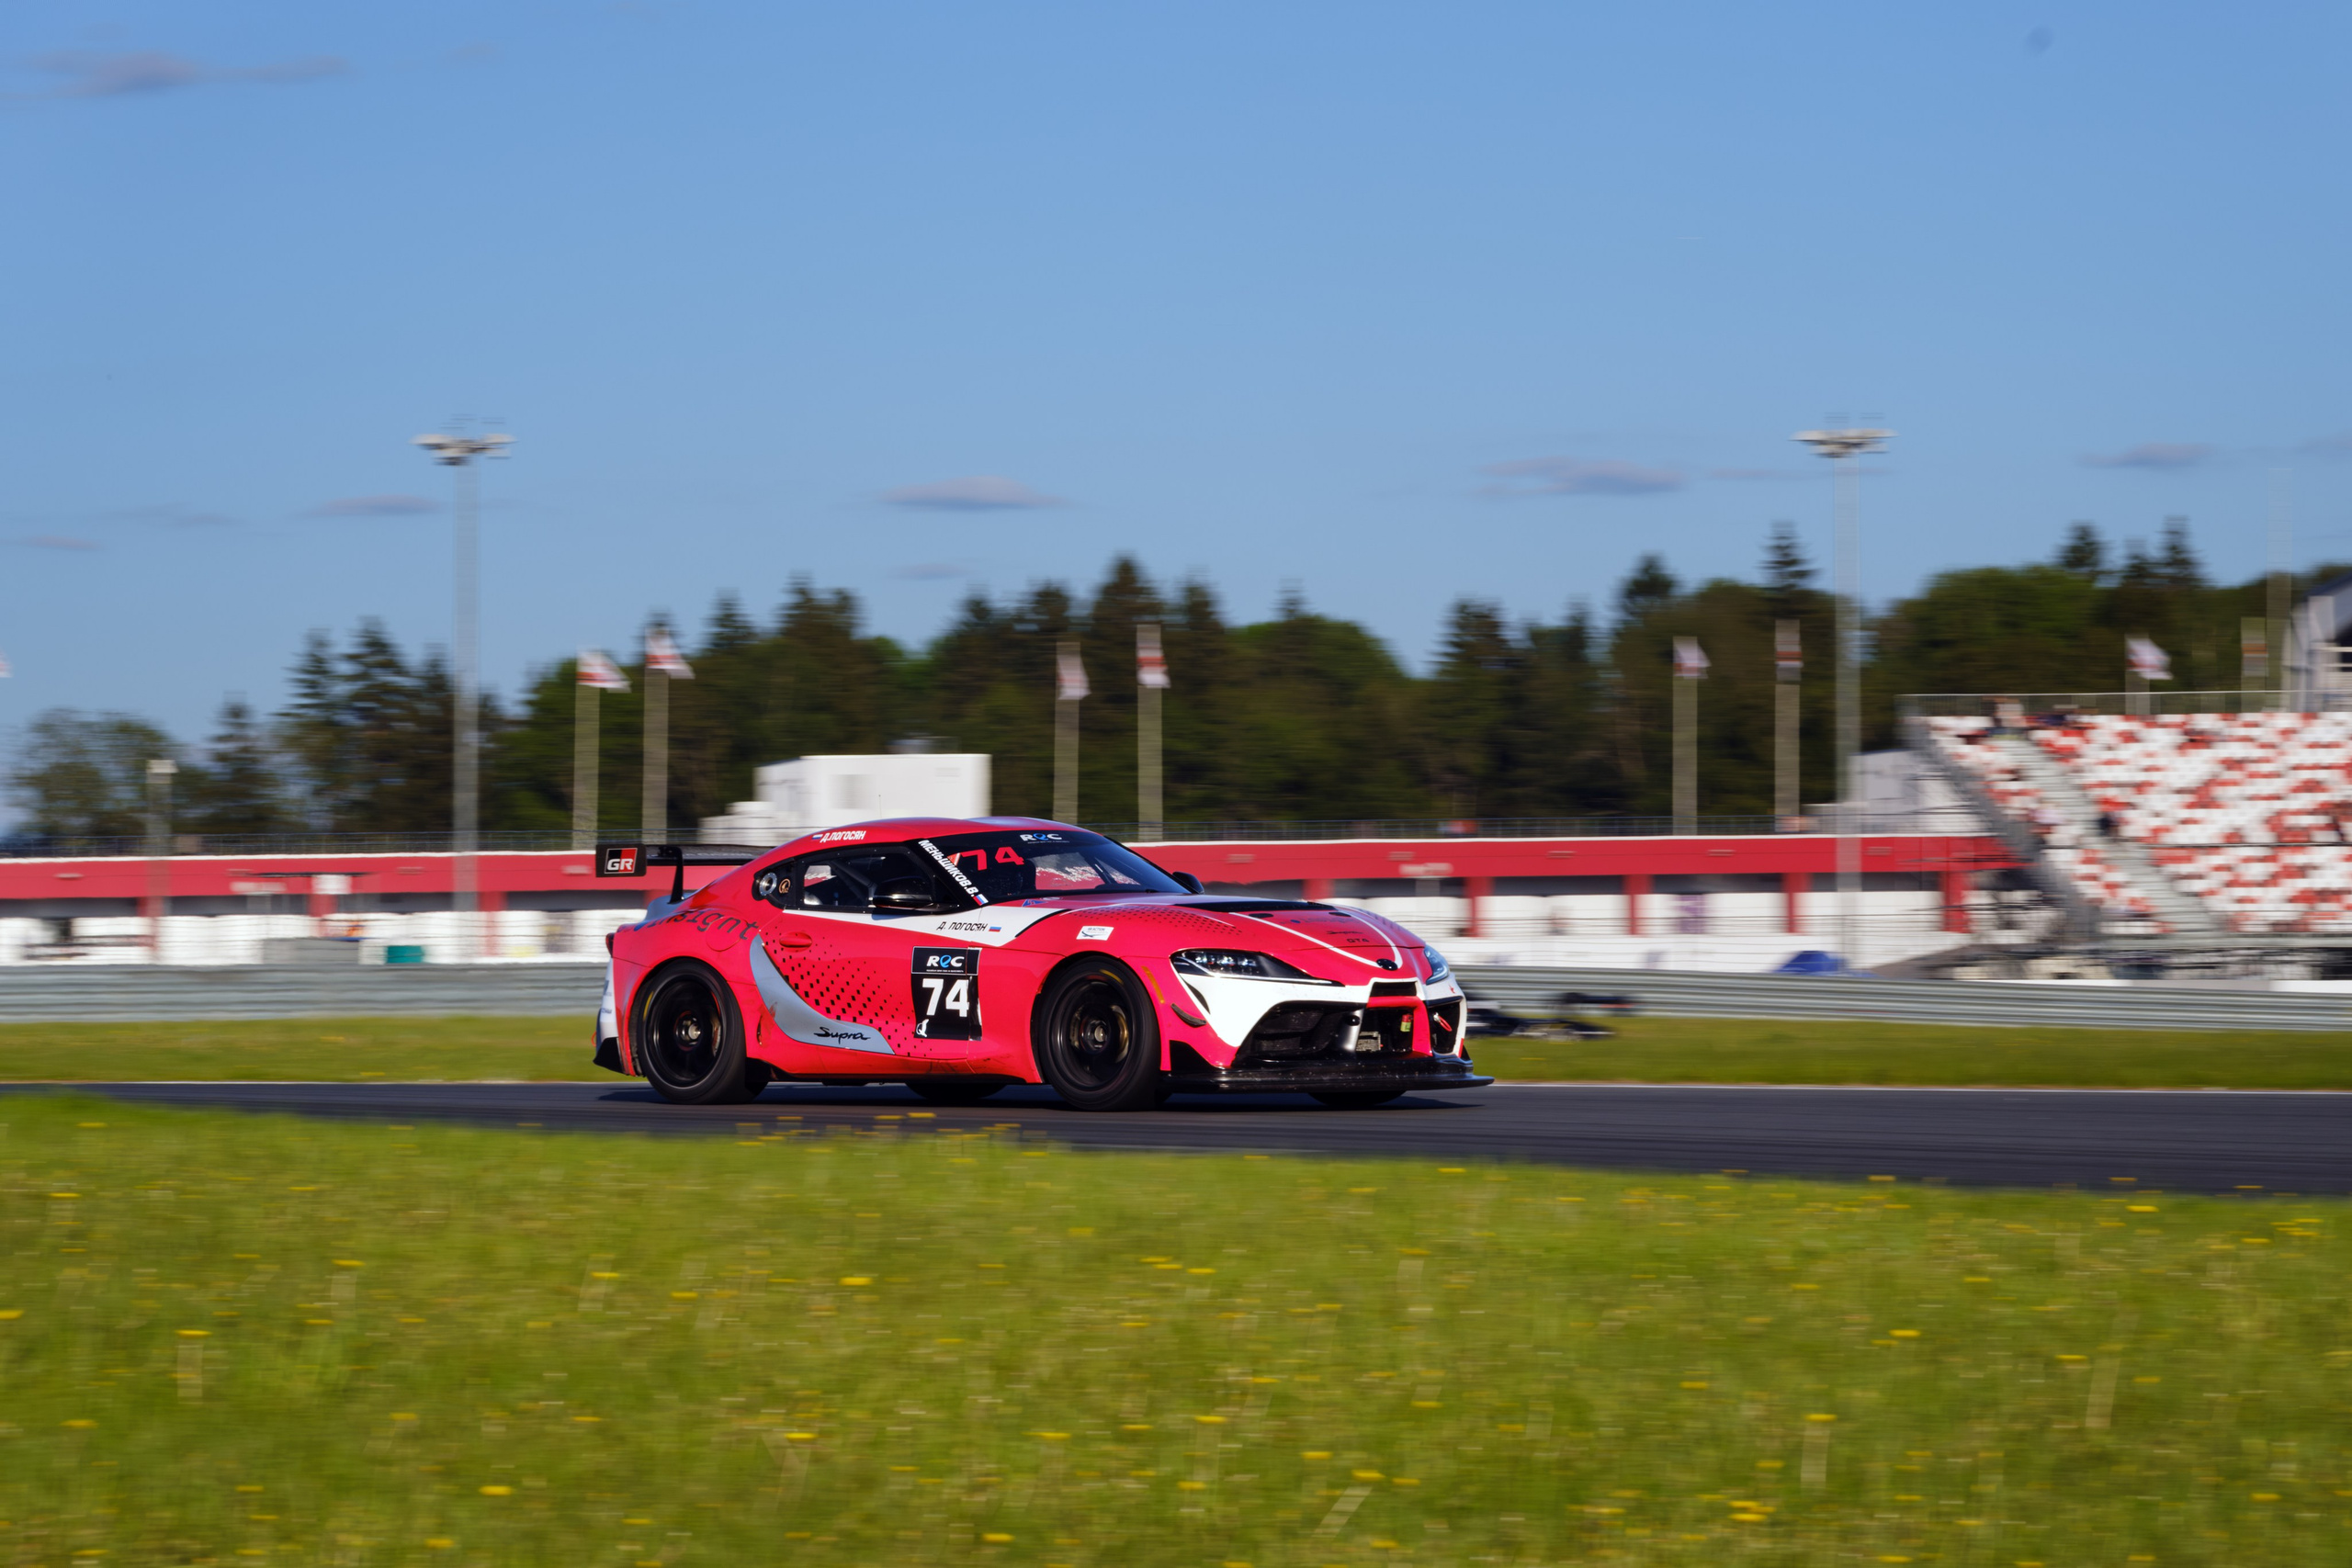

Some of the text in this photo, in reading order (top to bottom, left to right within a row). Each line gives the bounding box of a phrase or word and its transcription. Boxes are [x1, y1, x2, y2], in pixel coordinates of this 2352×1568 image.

[606, 858, 634, 871] GR
[959, 846, 1024, 871] 74
[948, 922, 989, 931] ПОГОСЯН
[922, 978, 970, 1017] 74
[813, 1026, 872, 1044] Supra
